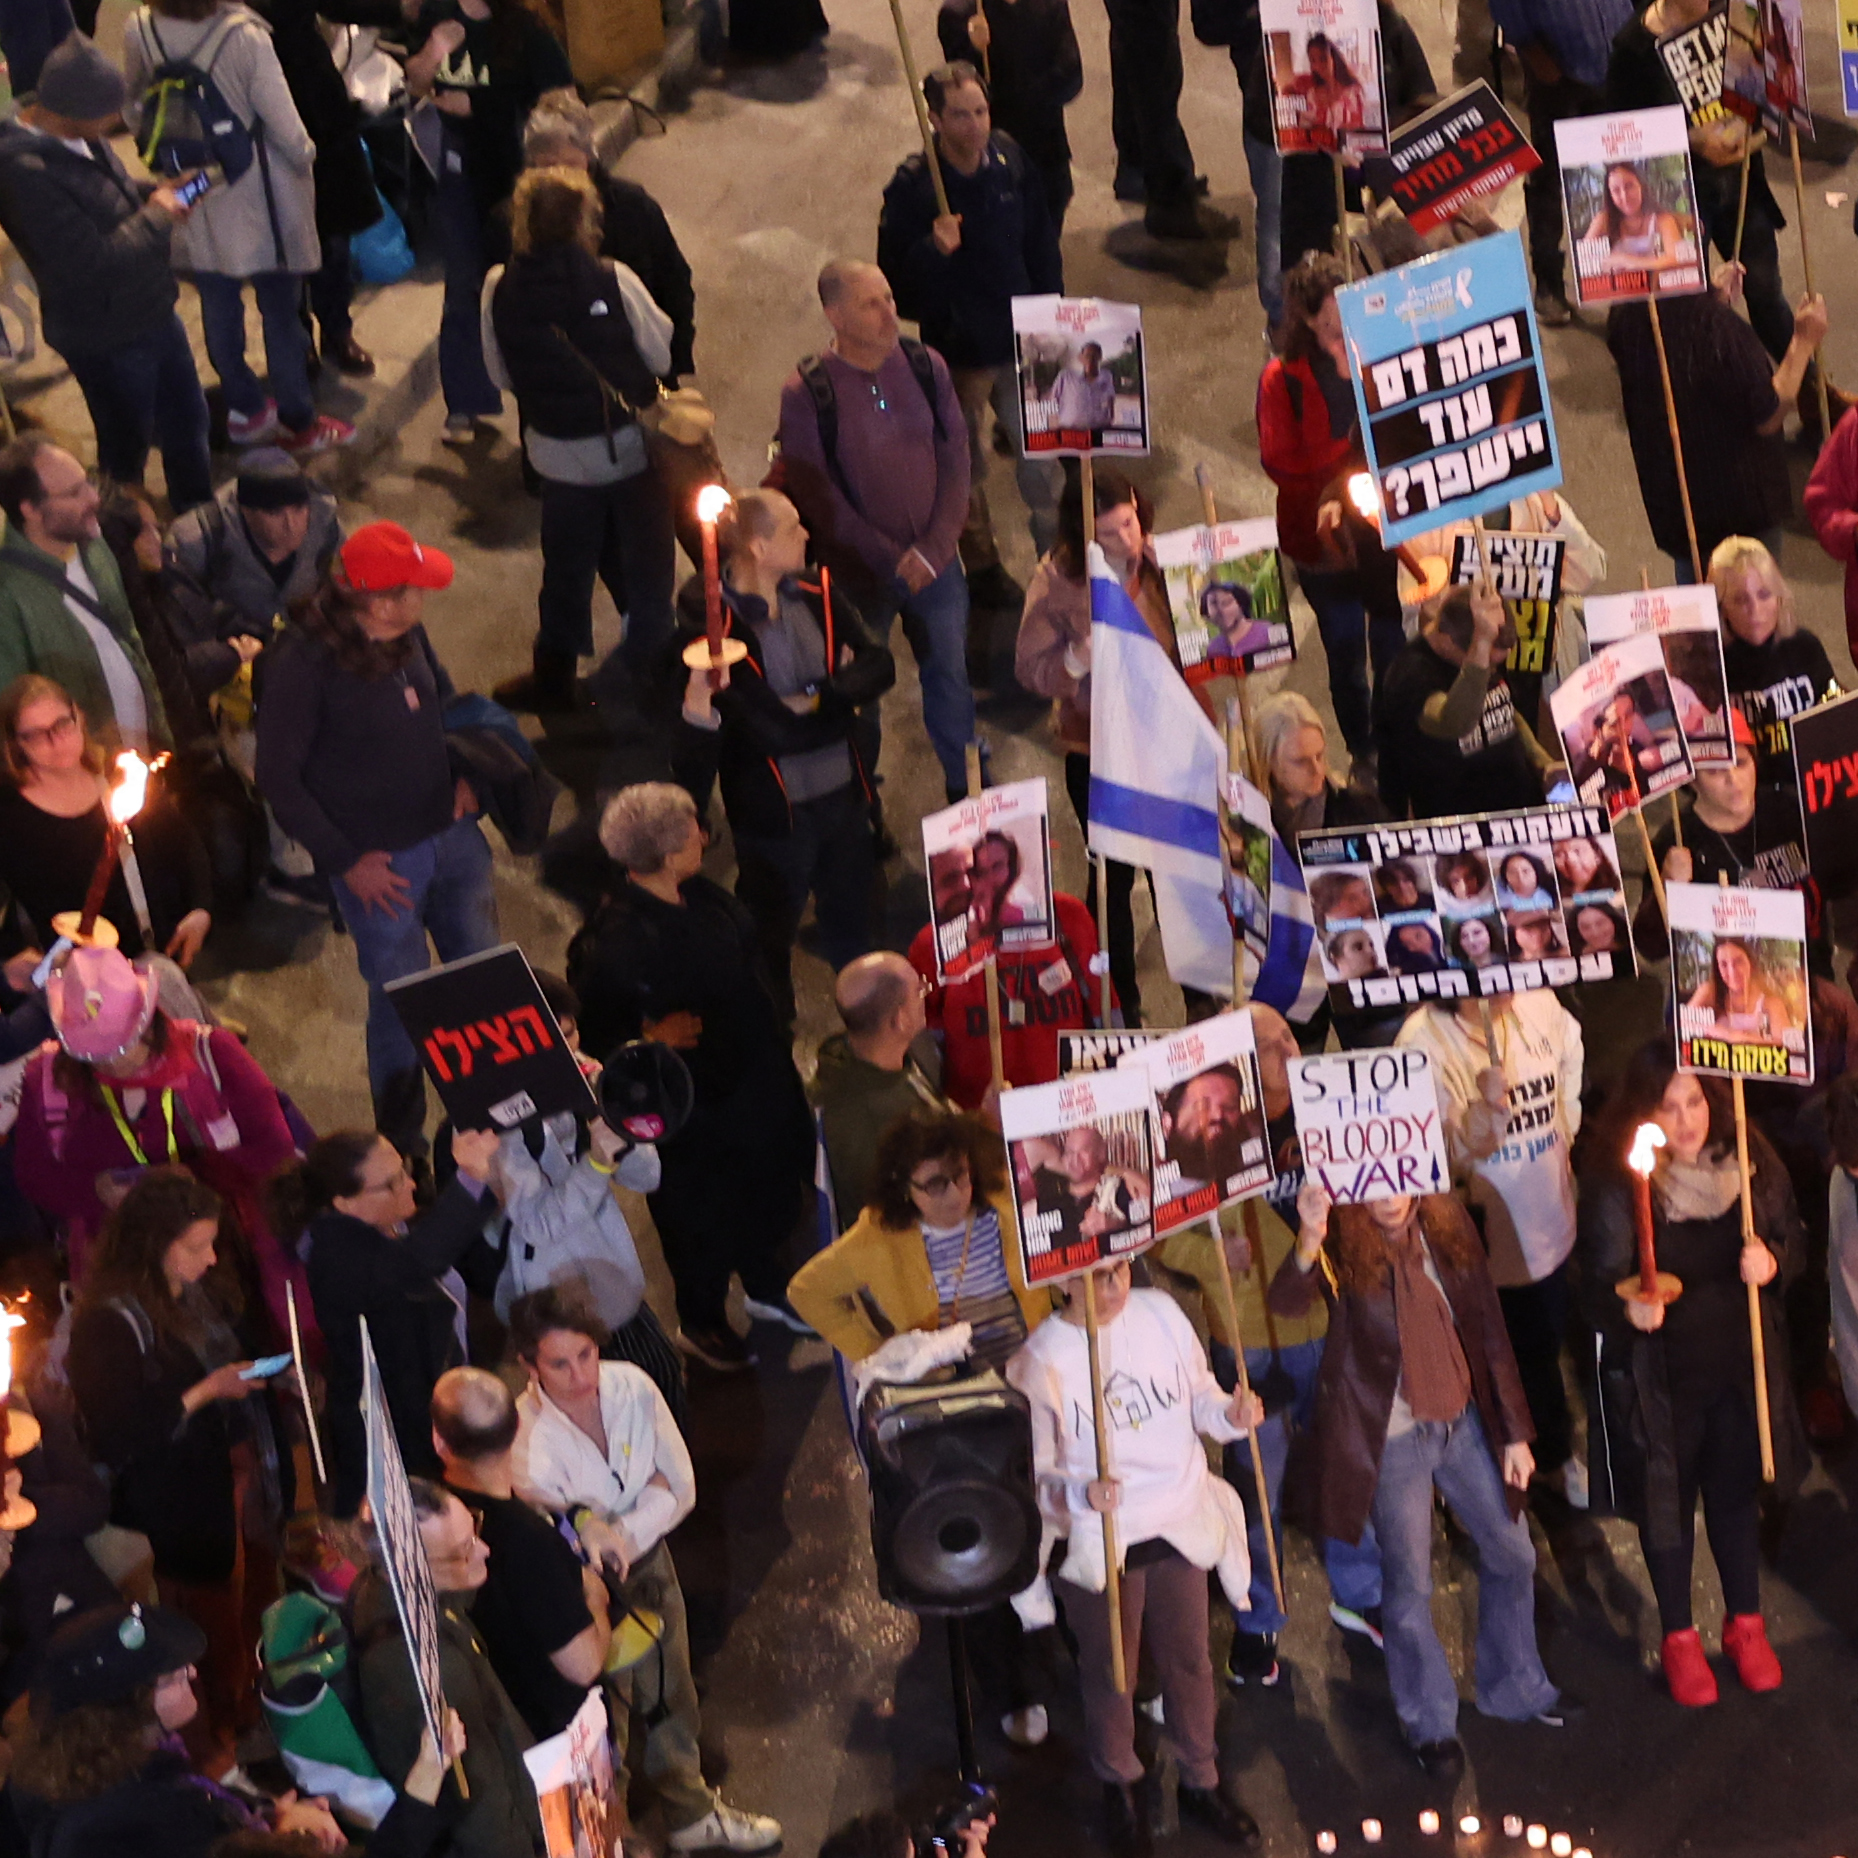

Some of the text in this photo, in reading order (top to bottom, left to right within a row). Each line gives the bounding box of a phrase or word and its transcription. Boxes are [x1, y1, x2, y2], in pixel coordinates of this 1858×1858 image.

[1371, 314, 1523, 403] כמה דם
[1417, 383, 1495, 447] עוד
[1385, 419, 1546, 519] יישפך?
[1510, 951, 1614, 989] עסקה
[424, 1002, 556, 1083] הצילו
[1300, 1049, 1428, 1105] STOP
[1327, 1093, 1391, 1120] THE
[1303, 1110, 1437, 1170] BLOODY
